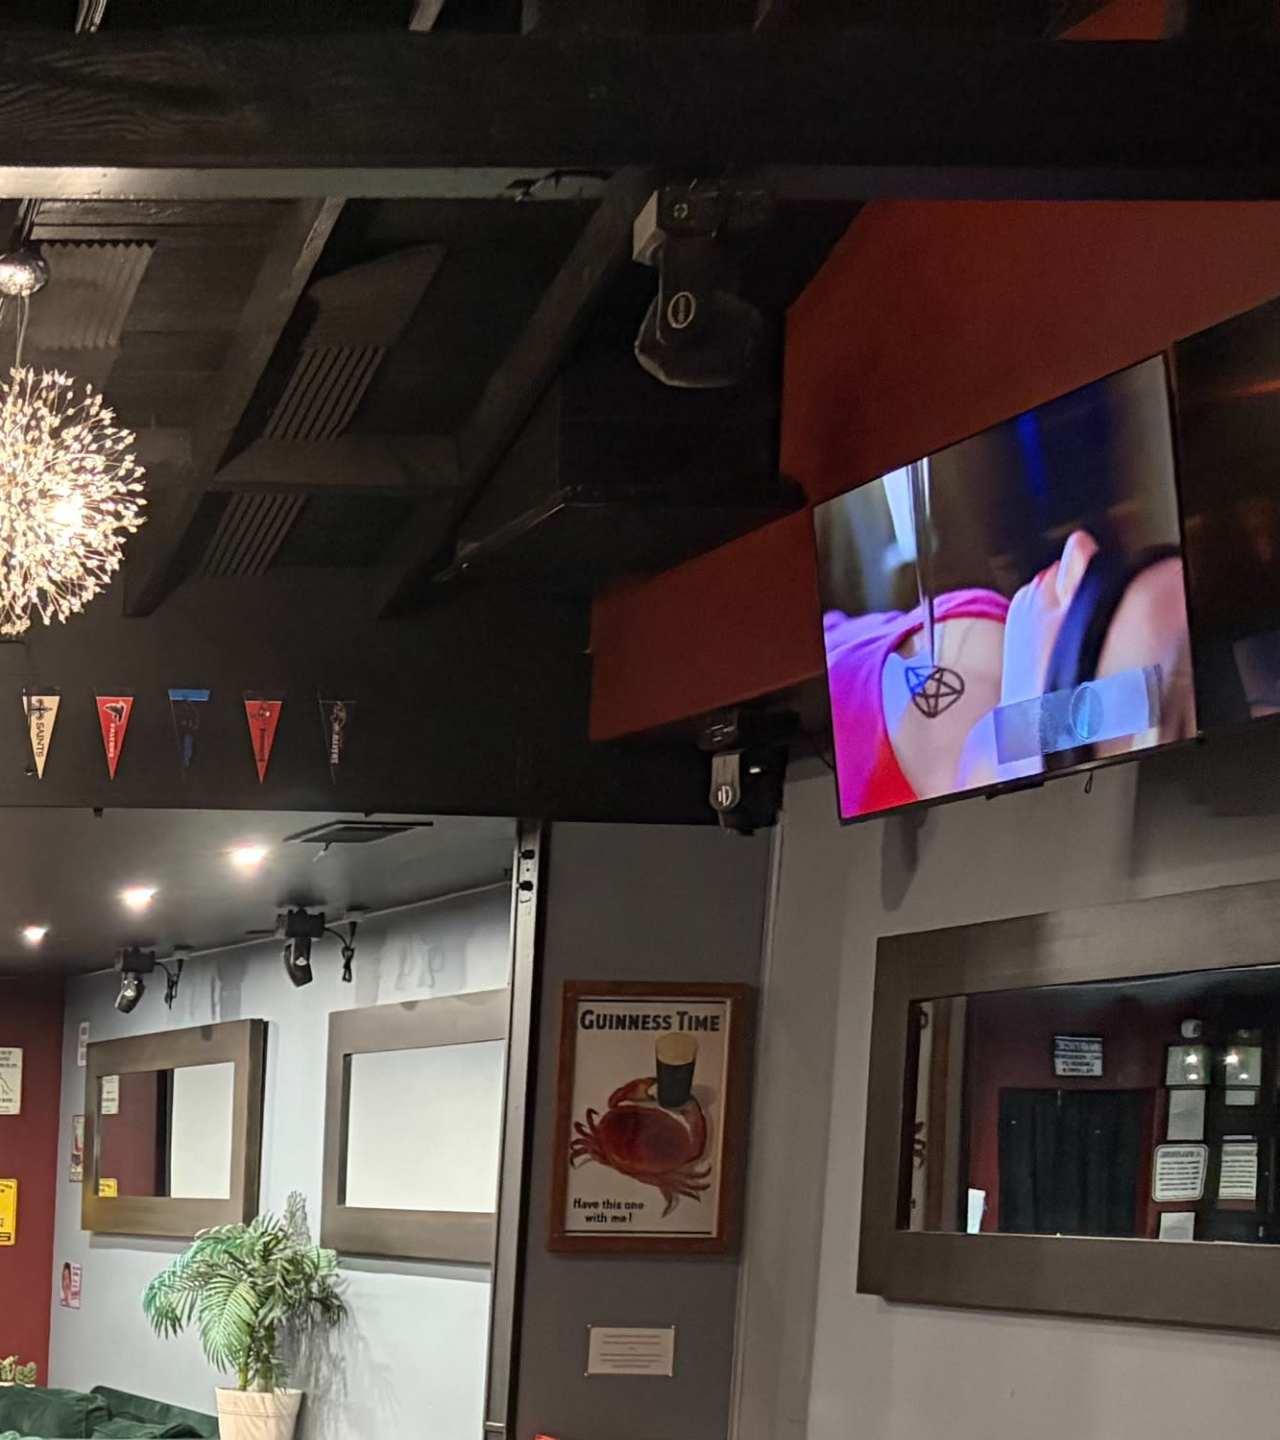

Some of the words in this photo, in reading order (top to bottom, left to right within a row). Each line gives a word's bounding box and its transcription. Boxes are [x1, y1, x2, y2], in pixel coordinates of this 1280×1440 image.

[35, 721, 45, 757] SAINTS
[579, 1009, 673, 1031] GUINNESS
[675, 1010, 721, 1032] TIME
[573, 1198, 599, 1210] Have
[602, 1198, 622, 1210] this
[624, 1202, 645, 1210] one
[585, 1211, 608, 1223] with
